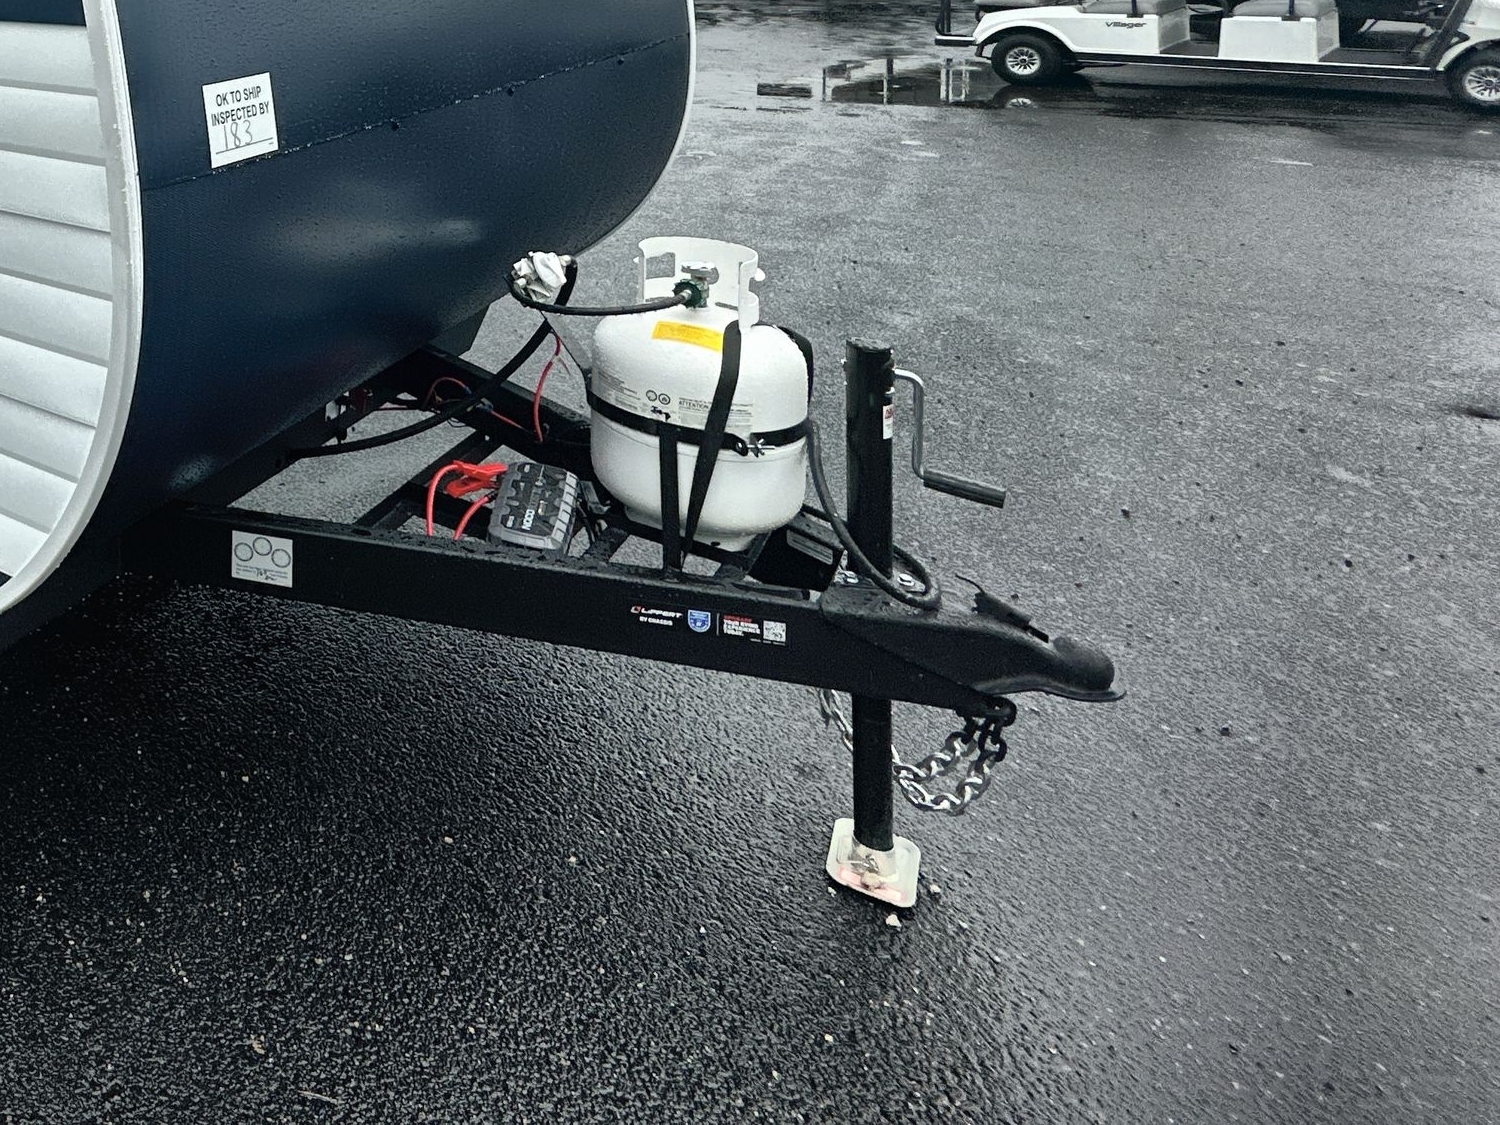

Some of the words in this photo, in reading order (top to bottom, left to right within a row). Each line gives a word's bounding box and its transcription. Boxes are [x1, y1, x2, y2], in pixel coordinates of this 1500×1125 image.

[215, 92, 229, 107] OK
[230, 89, 242, 104] TO
[243, 85, 262, 101] SHIP
[210, 104, 257, 127] INSPECTED
[258, 100, 270, 116] BY
[223, 119, 253, 151] 183
[678, 399, 710, 410] ATTENTION
[521, 508, 536, 531] NOCO
[641, 607, 684, 618] LIPPERT
